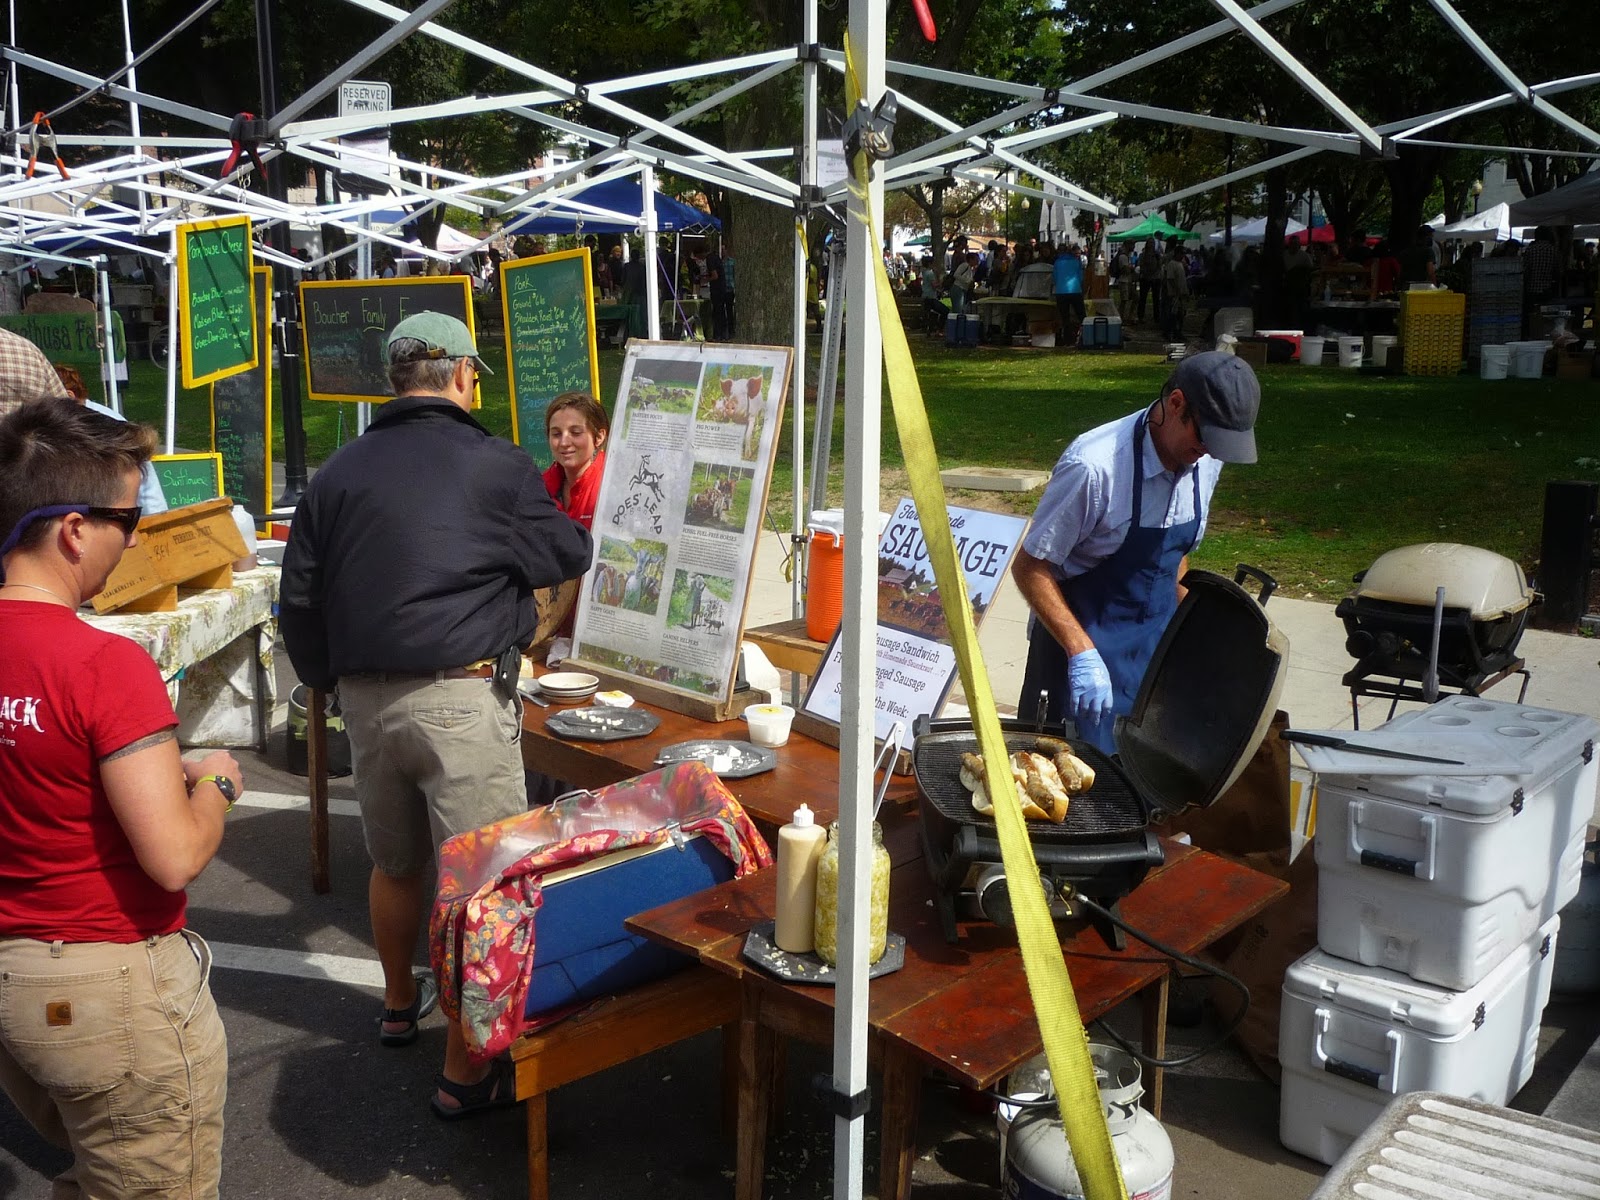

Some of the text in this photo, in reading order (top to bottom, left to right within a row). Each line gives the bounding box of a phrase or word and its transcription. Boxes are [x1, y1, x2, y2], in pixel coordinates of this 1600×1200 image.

[343, 87, 387, 100] RESERVED
[347, 100, 384, 112] PARKING
[514, 272, 534, 290] Pork
[313, 300, 350, 324] Boucher
[362, 298, 387, 331] Family
[162, 468, 208, 486] Sunflower
[644, 497, 662, 534] LEAP
[881, 523, 1009, 578] SAUAGE
[876, 633, 940, 663] ausage Sandwich
[883, 651, 907, 666] Homemade
[893, 671, 926, 692] Sausage
[886, 700, 910, 718] Week:
